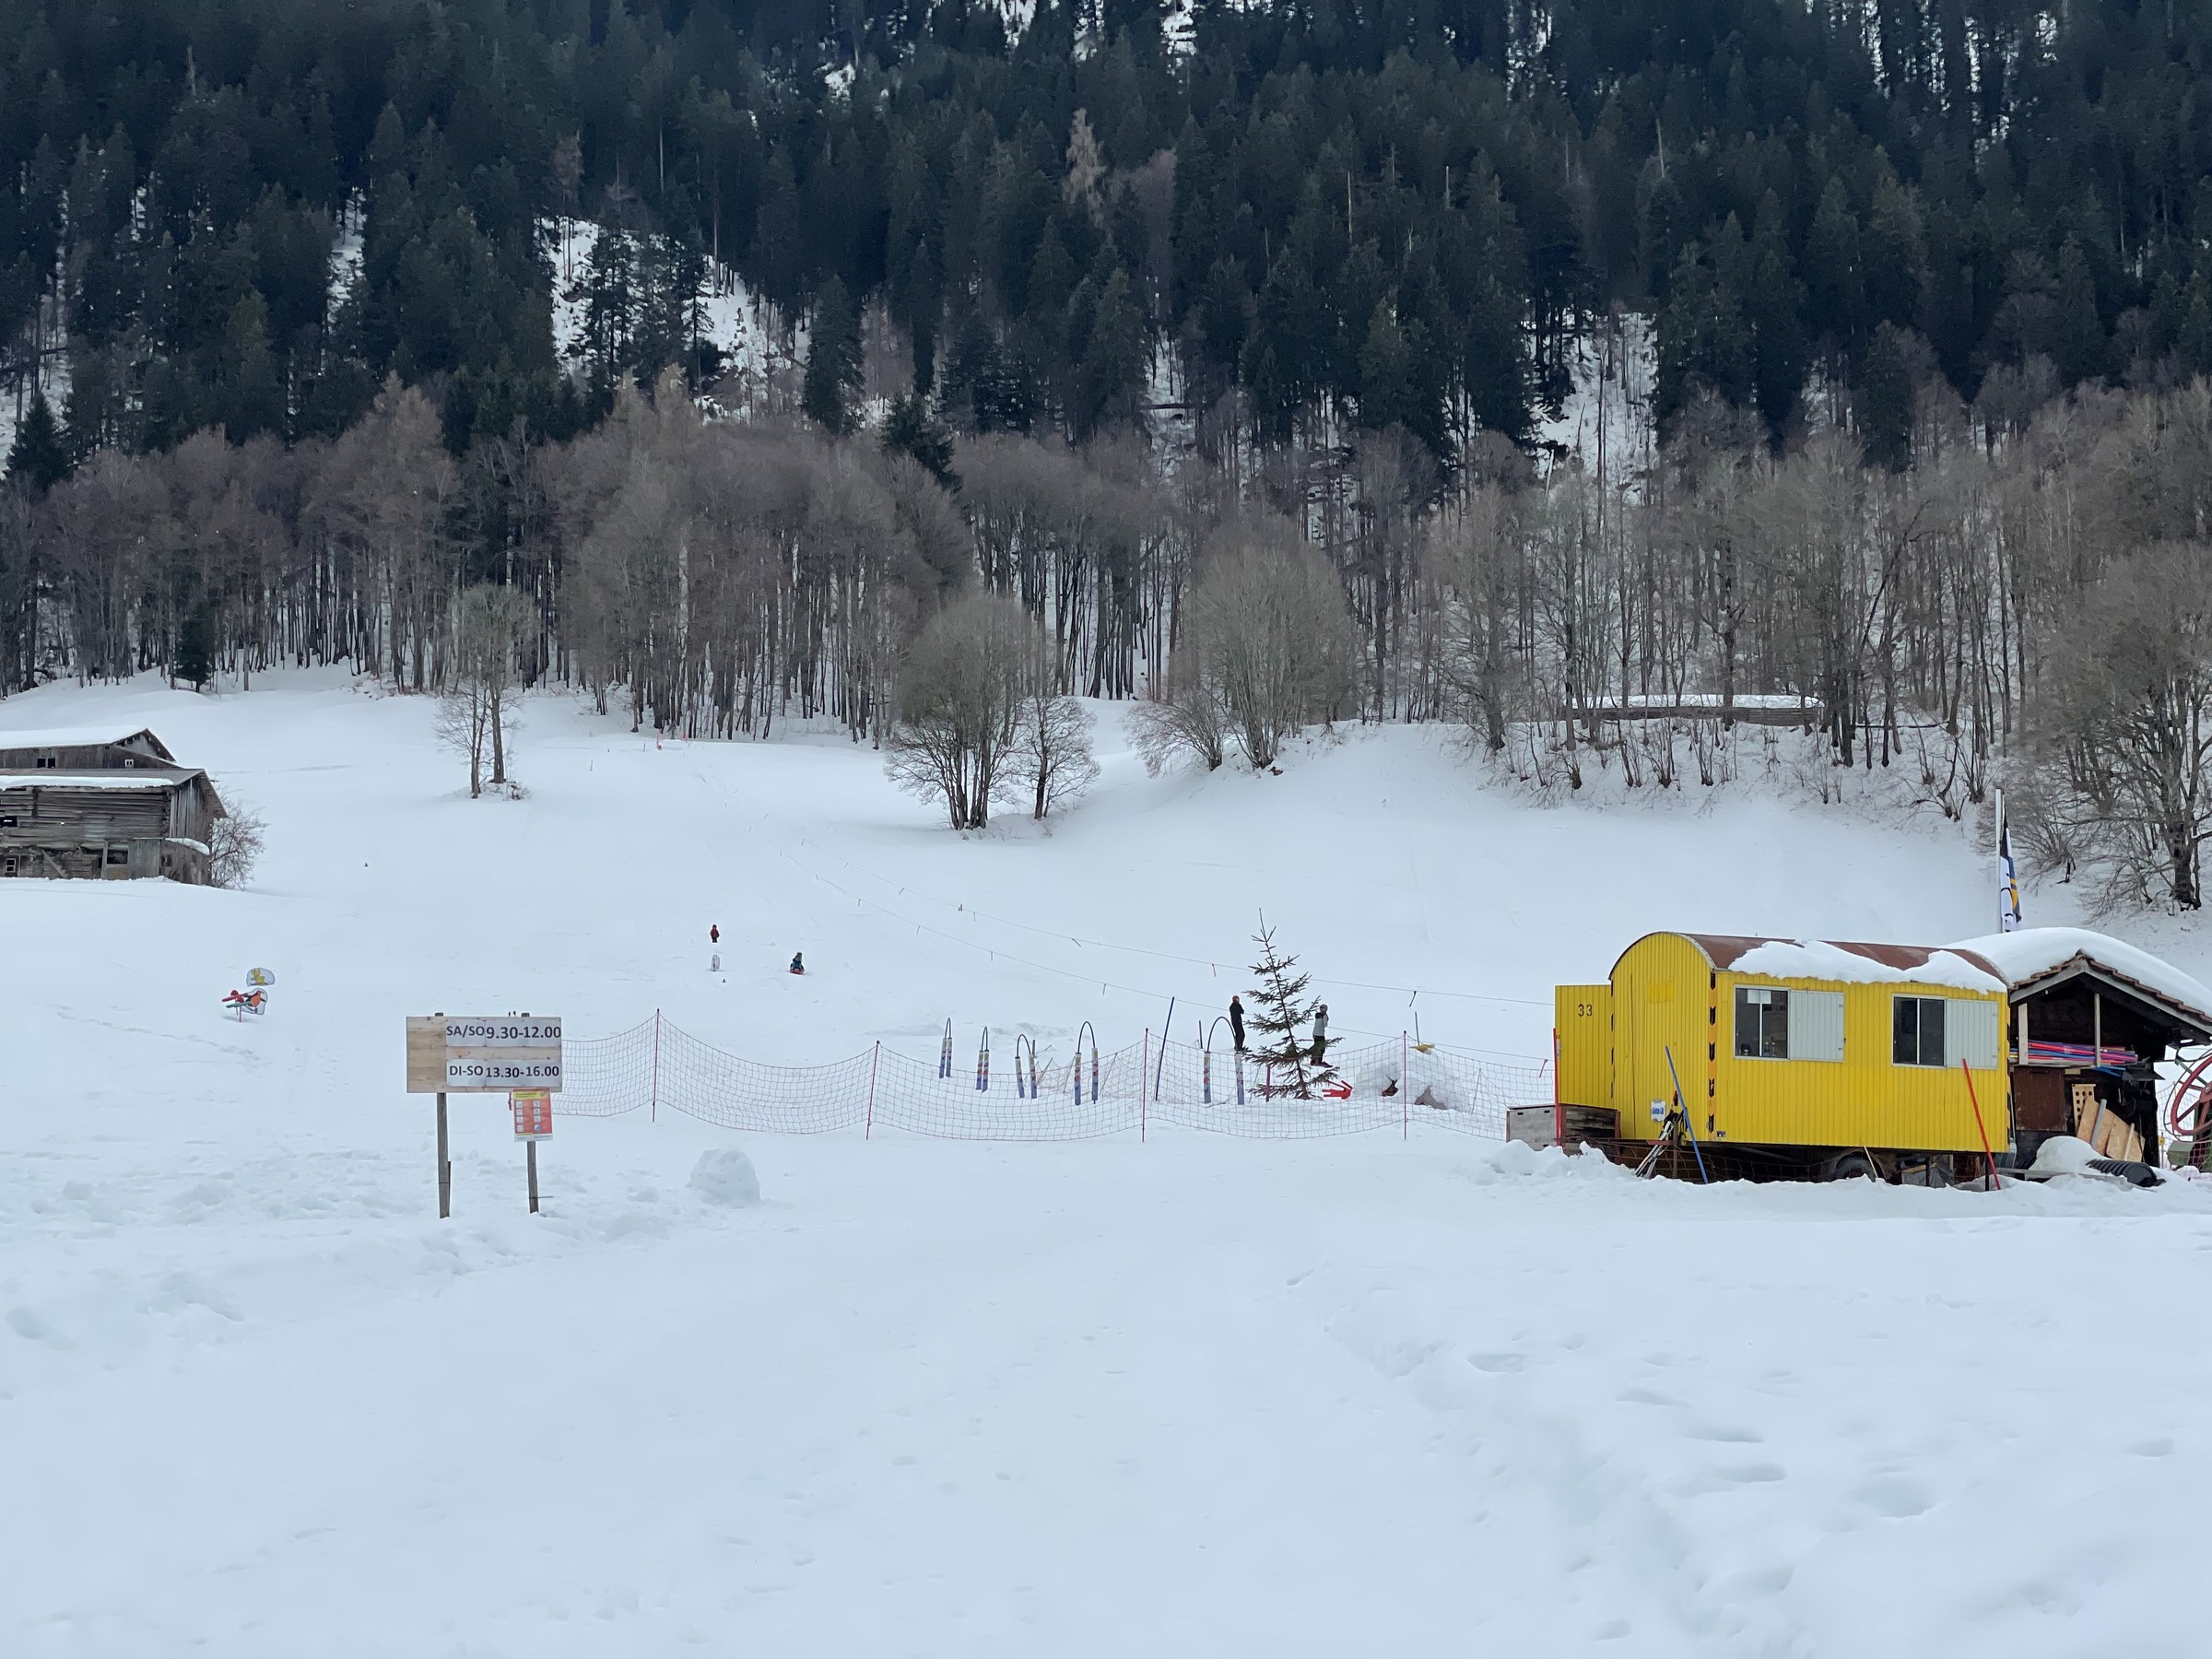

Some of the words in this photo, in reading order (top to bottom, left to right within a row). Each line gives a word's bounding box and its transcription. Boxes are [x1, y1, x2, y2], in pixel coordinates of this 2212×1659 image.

[1578, 1004, 1593, 1017] 33
[446, 1025, 485, 1038] SA/SO
[449, 1065, 484, 1076] DI-SO
